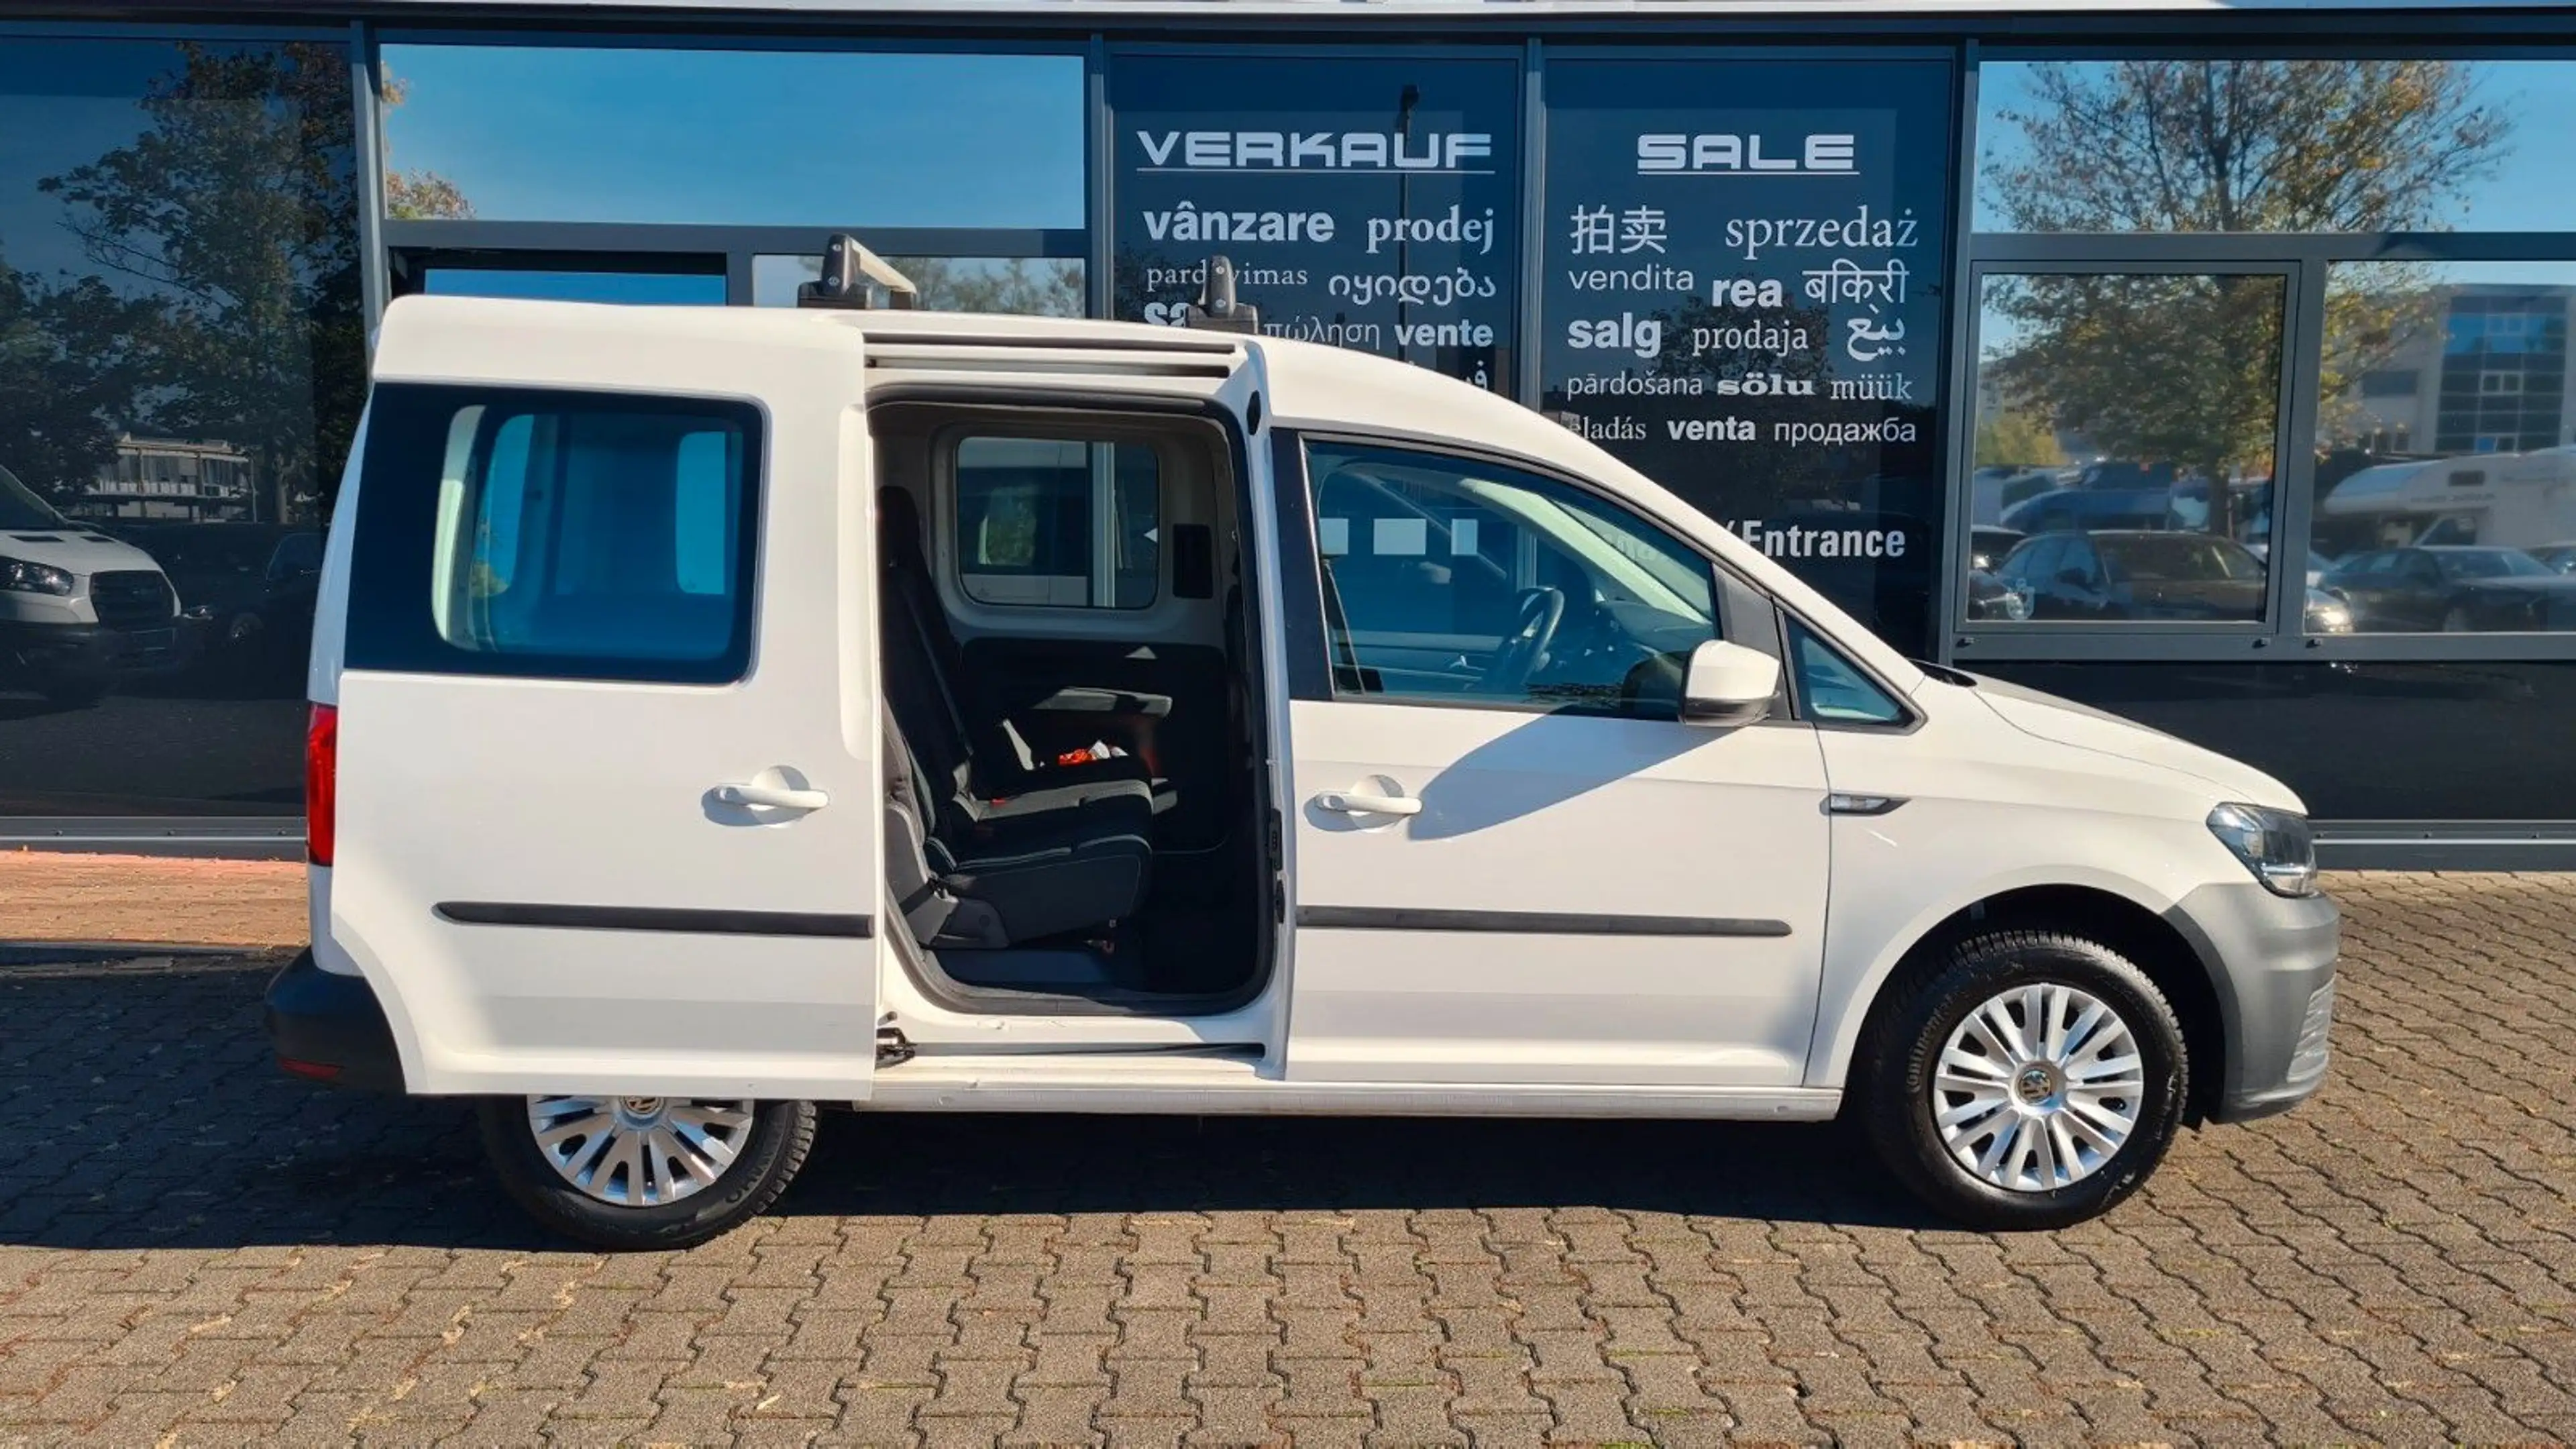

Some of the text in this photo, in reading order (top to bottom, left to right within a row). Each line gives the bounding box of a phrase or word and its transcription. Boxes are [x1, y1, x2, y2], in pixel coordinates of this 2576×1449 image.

[1136, 131, 1492, 168] VERKAUF
[1637, 134, 1855, 170] SALE
[1142, 201, 1494, 254] vânzare prodej
[1570, 204, 1668, 254] 拍卖
[1725, 205, 1918, 261] sprzedaż
[1146, 258, 1309, 292] pardvimas
[1568, 264, 1694, 291] vendita
[1711, 278, 1783, 308] rea
[1394, 319, 1494, 347] vente
[1567, 312, 1662, 359] salg
[1691, 320, 1809, 358] prodaja
[1567, 370, 1912, 401] pārdošana sölu müük
[1667, 417, 1757, 441] venta
[1774, 417, 1917, 447] продажба
